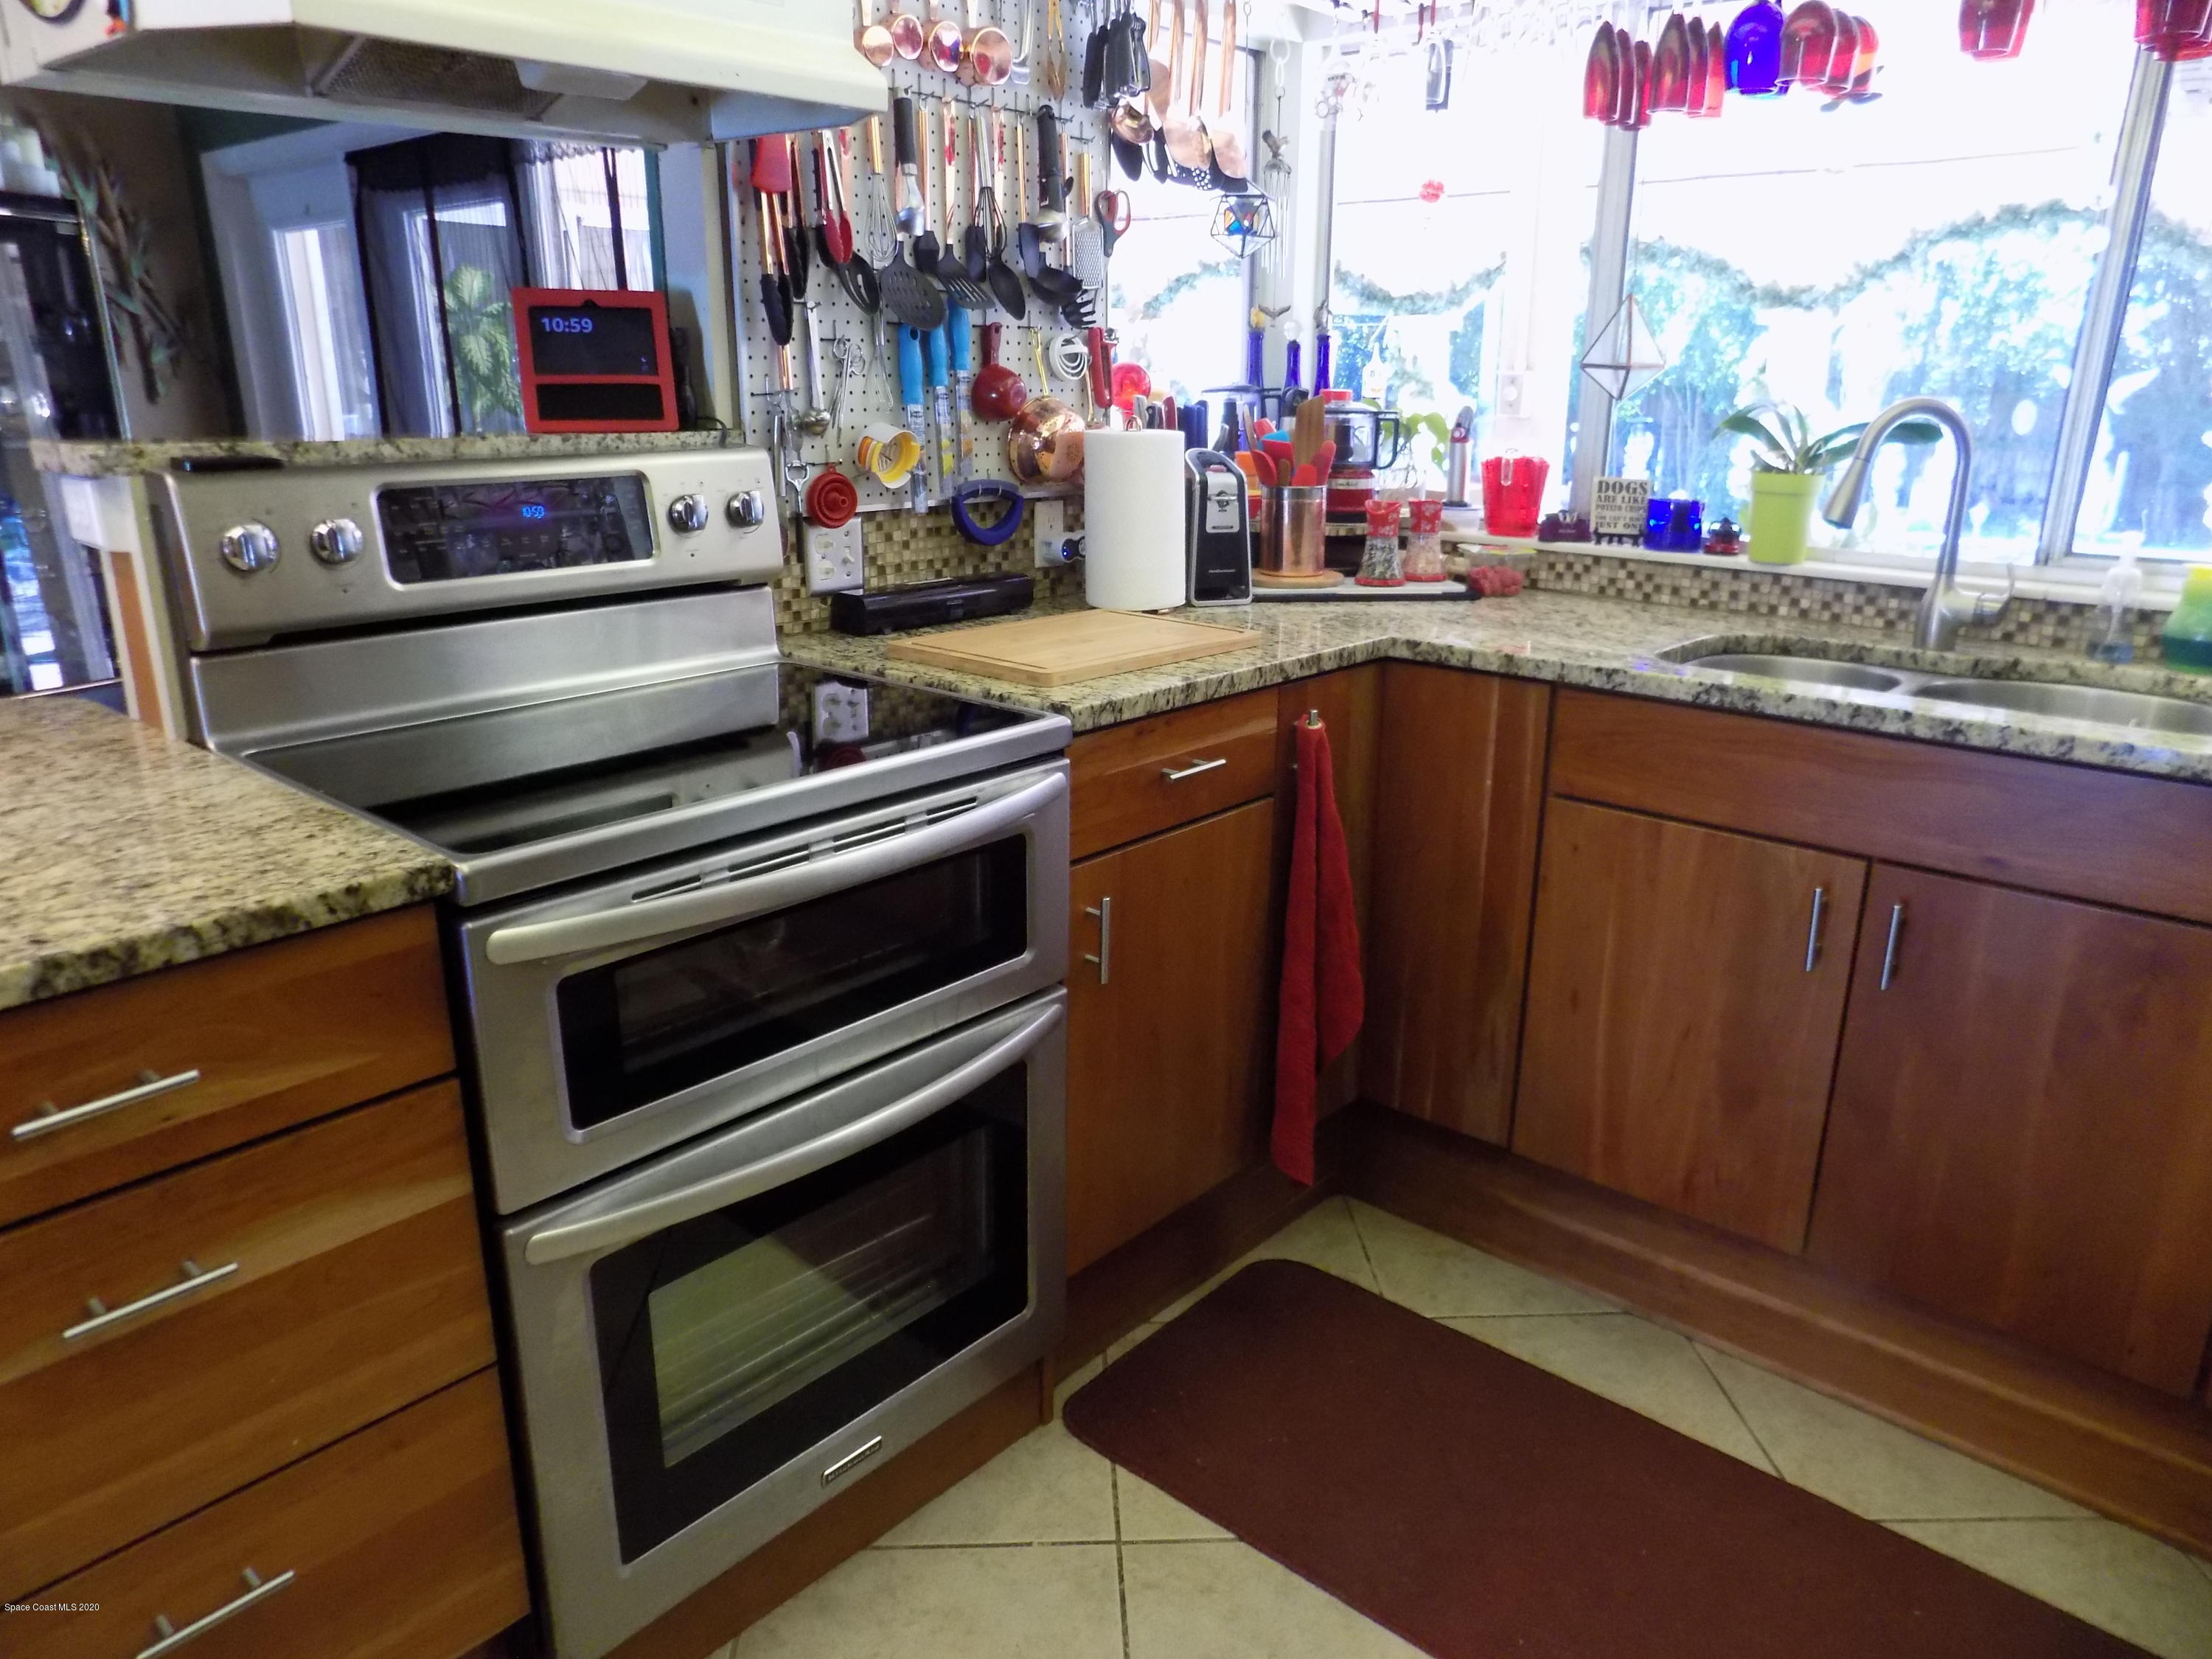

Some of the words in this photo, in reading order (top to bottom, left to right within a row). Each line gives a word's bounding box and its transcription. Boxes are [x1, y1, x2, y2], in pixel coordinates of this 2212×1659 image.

[540, 316, 593, 333] 10:59
[1597, 481, 1648, 495] DOGS
[1596, 495, 1617, 503] ARE
[1621, 495, 1646, 505] LIKE
